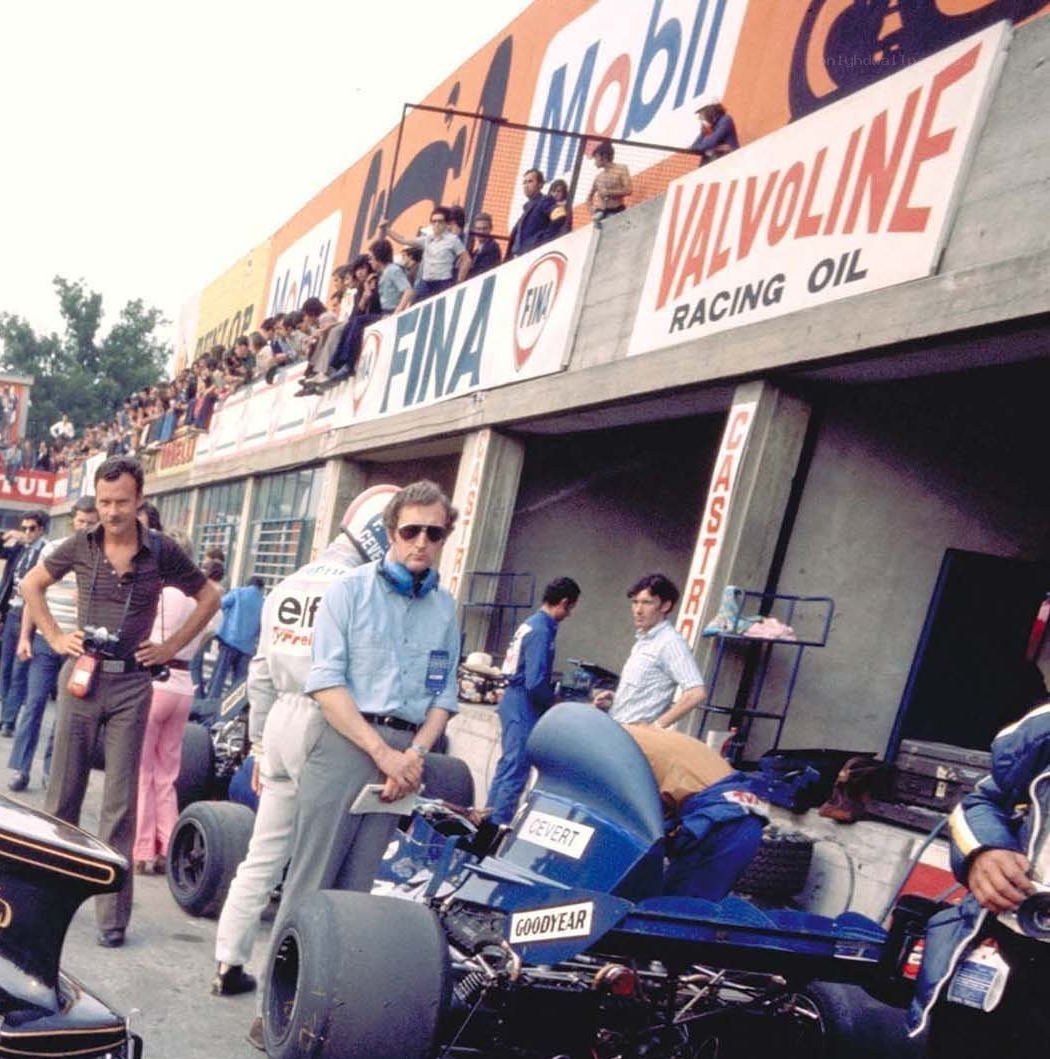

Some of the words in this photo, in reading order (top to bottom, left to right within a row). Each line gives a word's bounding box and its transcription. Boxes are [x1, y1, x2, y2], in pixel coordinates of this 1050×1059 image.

[533, 0, 729, 183] Mobil
[655, 42, 983, 311] VALVOLINE
[521, 280, 554, 329] FINA
[669, 273, 786, 334] RACING
[808, 248, 869, 294] OIL
[380, 274, 497, 413] FINA
[278, 596, 323, 629] elf
[528, 818, 581, 848] CEVERT
[515, 909, 587, 937] GOODYEAR
